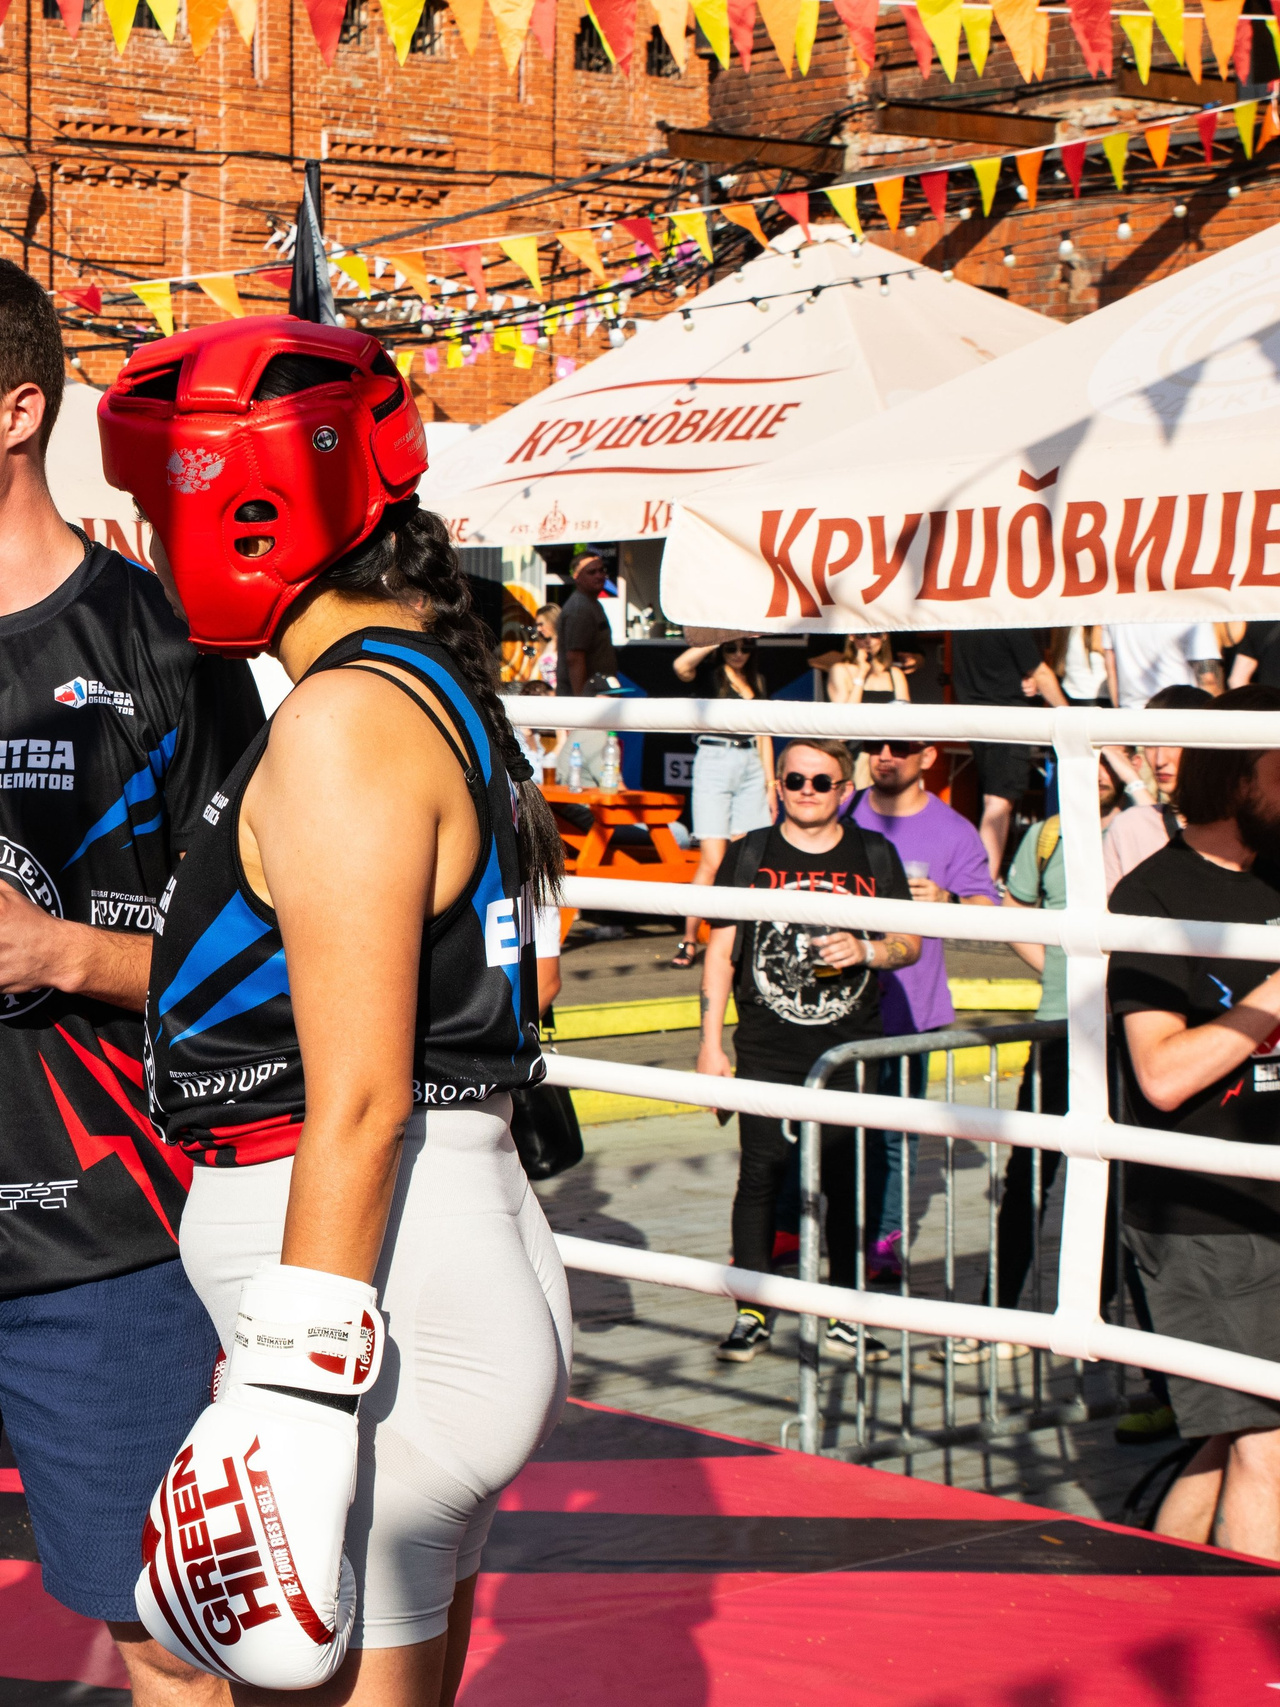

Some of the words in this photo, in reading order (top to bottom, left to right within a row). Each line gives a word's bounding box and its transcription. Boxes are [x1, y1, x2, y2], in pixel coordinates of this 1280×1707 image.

[307, 1327, 349, 1339] ULTIMATUM
[254, 1484, 275, 1515] SELF
[173, 1444, 242, 1646] GREEN
[202, 1456, 282, 1631] HILL
[263, 1516, 286, 1548] BEST
[273, 1547, 295, 1581] YOUR
[283, 1580, 302, 1597] BE
